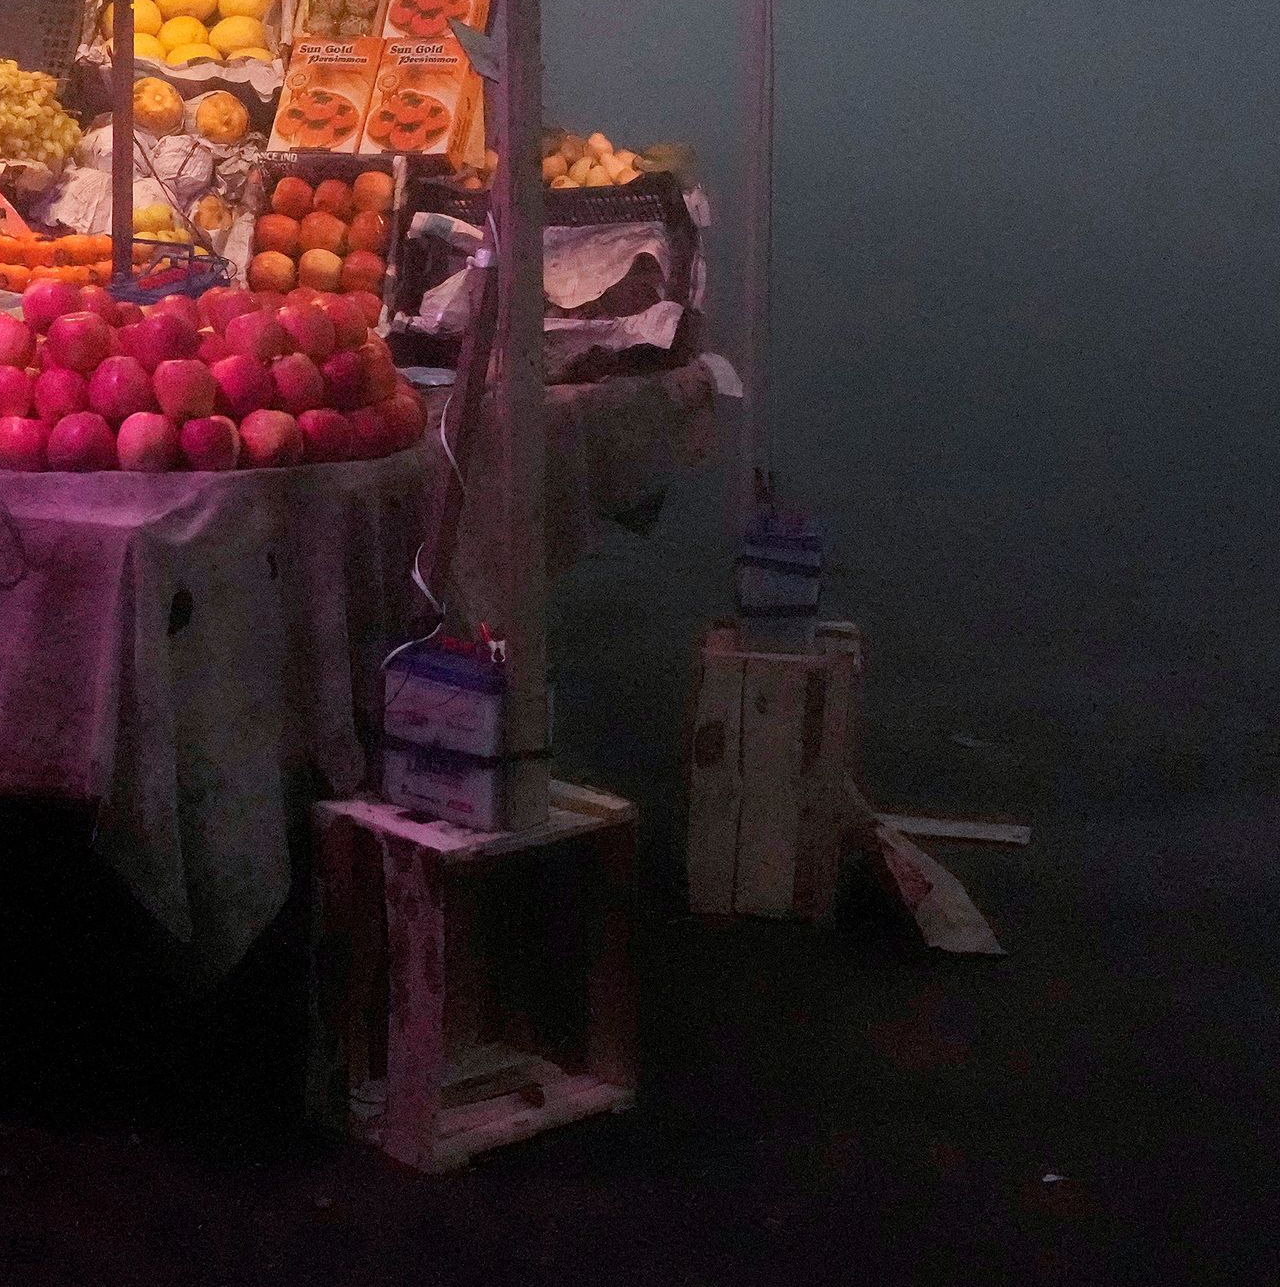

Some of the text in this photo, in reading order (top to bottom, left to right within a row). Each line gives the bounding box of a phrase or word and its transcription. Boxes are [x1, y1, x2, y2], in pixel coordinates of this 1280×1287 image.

[299, 44, 354, 54] Sun Gold
[389, 44, 444, 54] Sun Gold
[307, 54, 368, 64] Persimmon
[398, 55, 459, 65] Persimmon
